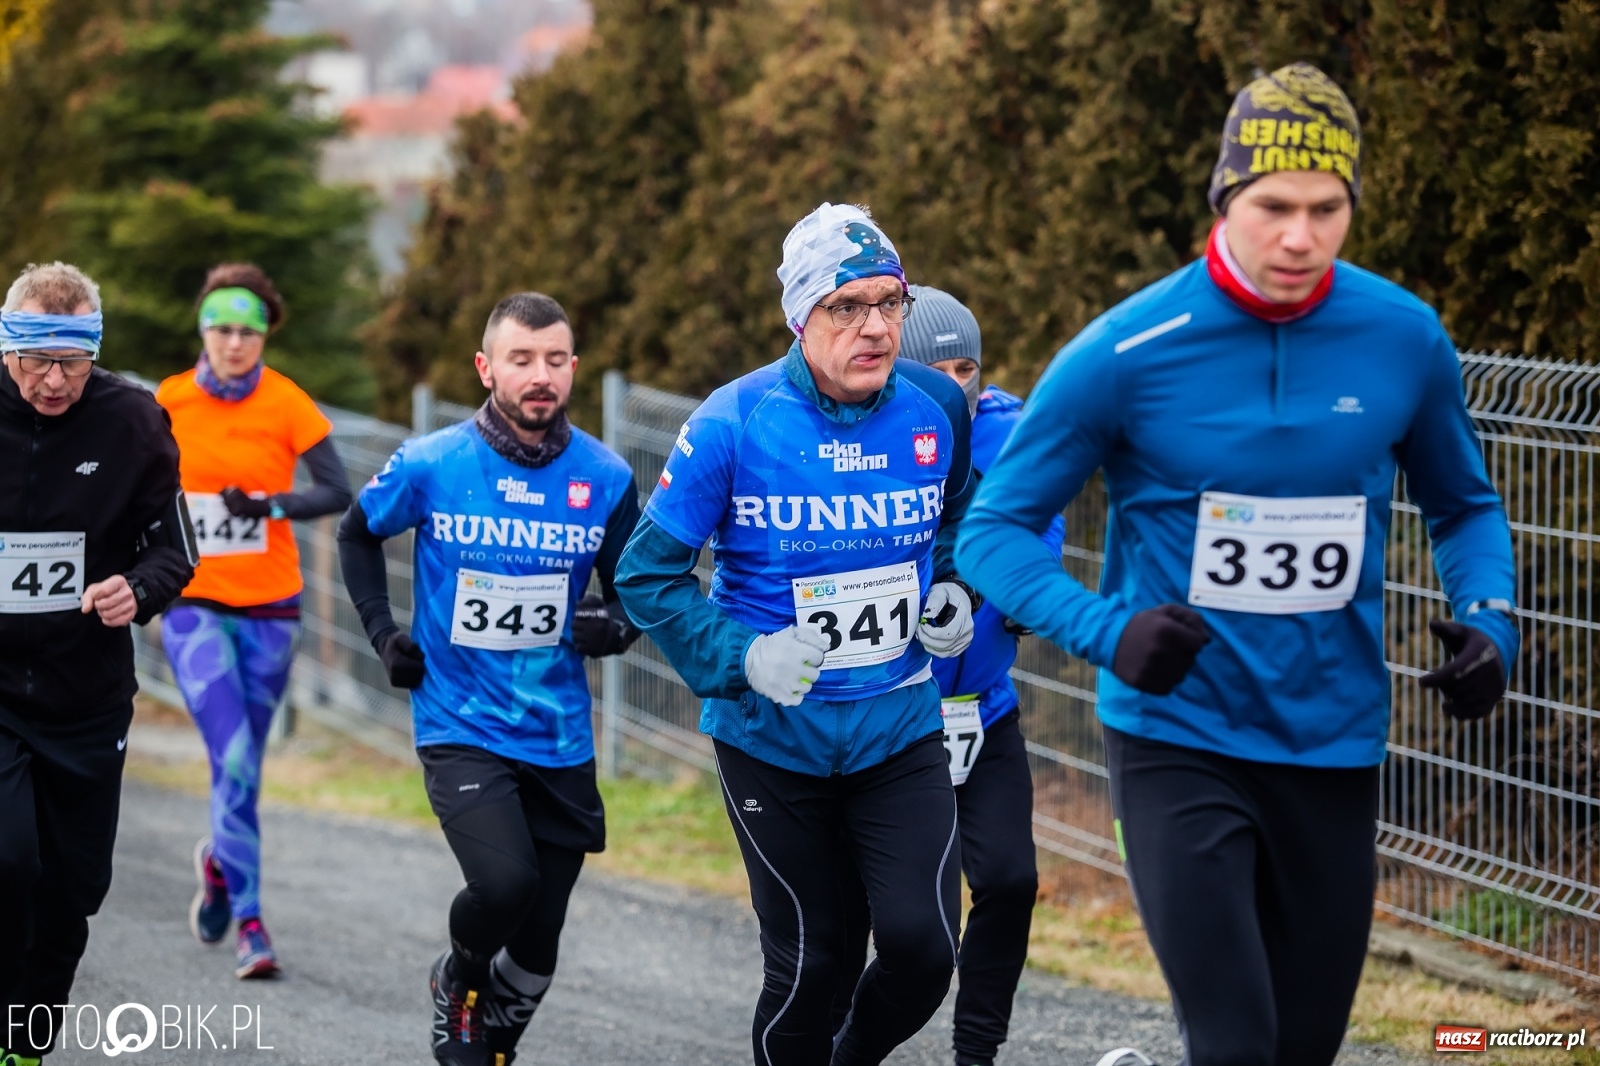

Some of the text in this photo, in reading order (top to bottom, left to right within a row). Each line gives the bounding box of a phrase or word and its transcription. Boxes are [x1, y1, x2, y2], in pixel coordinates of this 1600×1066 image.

[75, 461, 100, 475] 4F
[732, 478, 946, 532] RUNNER
[431, 511, 606, 554] RUNNERS
[892, 528, 933, 547] TEAM
[11, 561, 77, 597] 42
[538, 556, 574, 569] TEAM
[1206, 538, 1350, 590] 339
[842, 572, 914, 592] www.personalbest.pl
[461, 599, 558, 636] 343
[806, 597, 910, 652] 341
